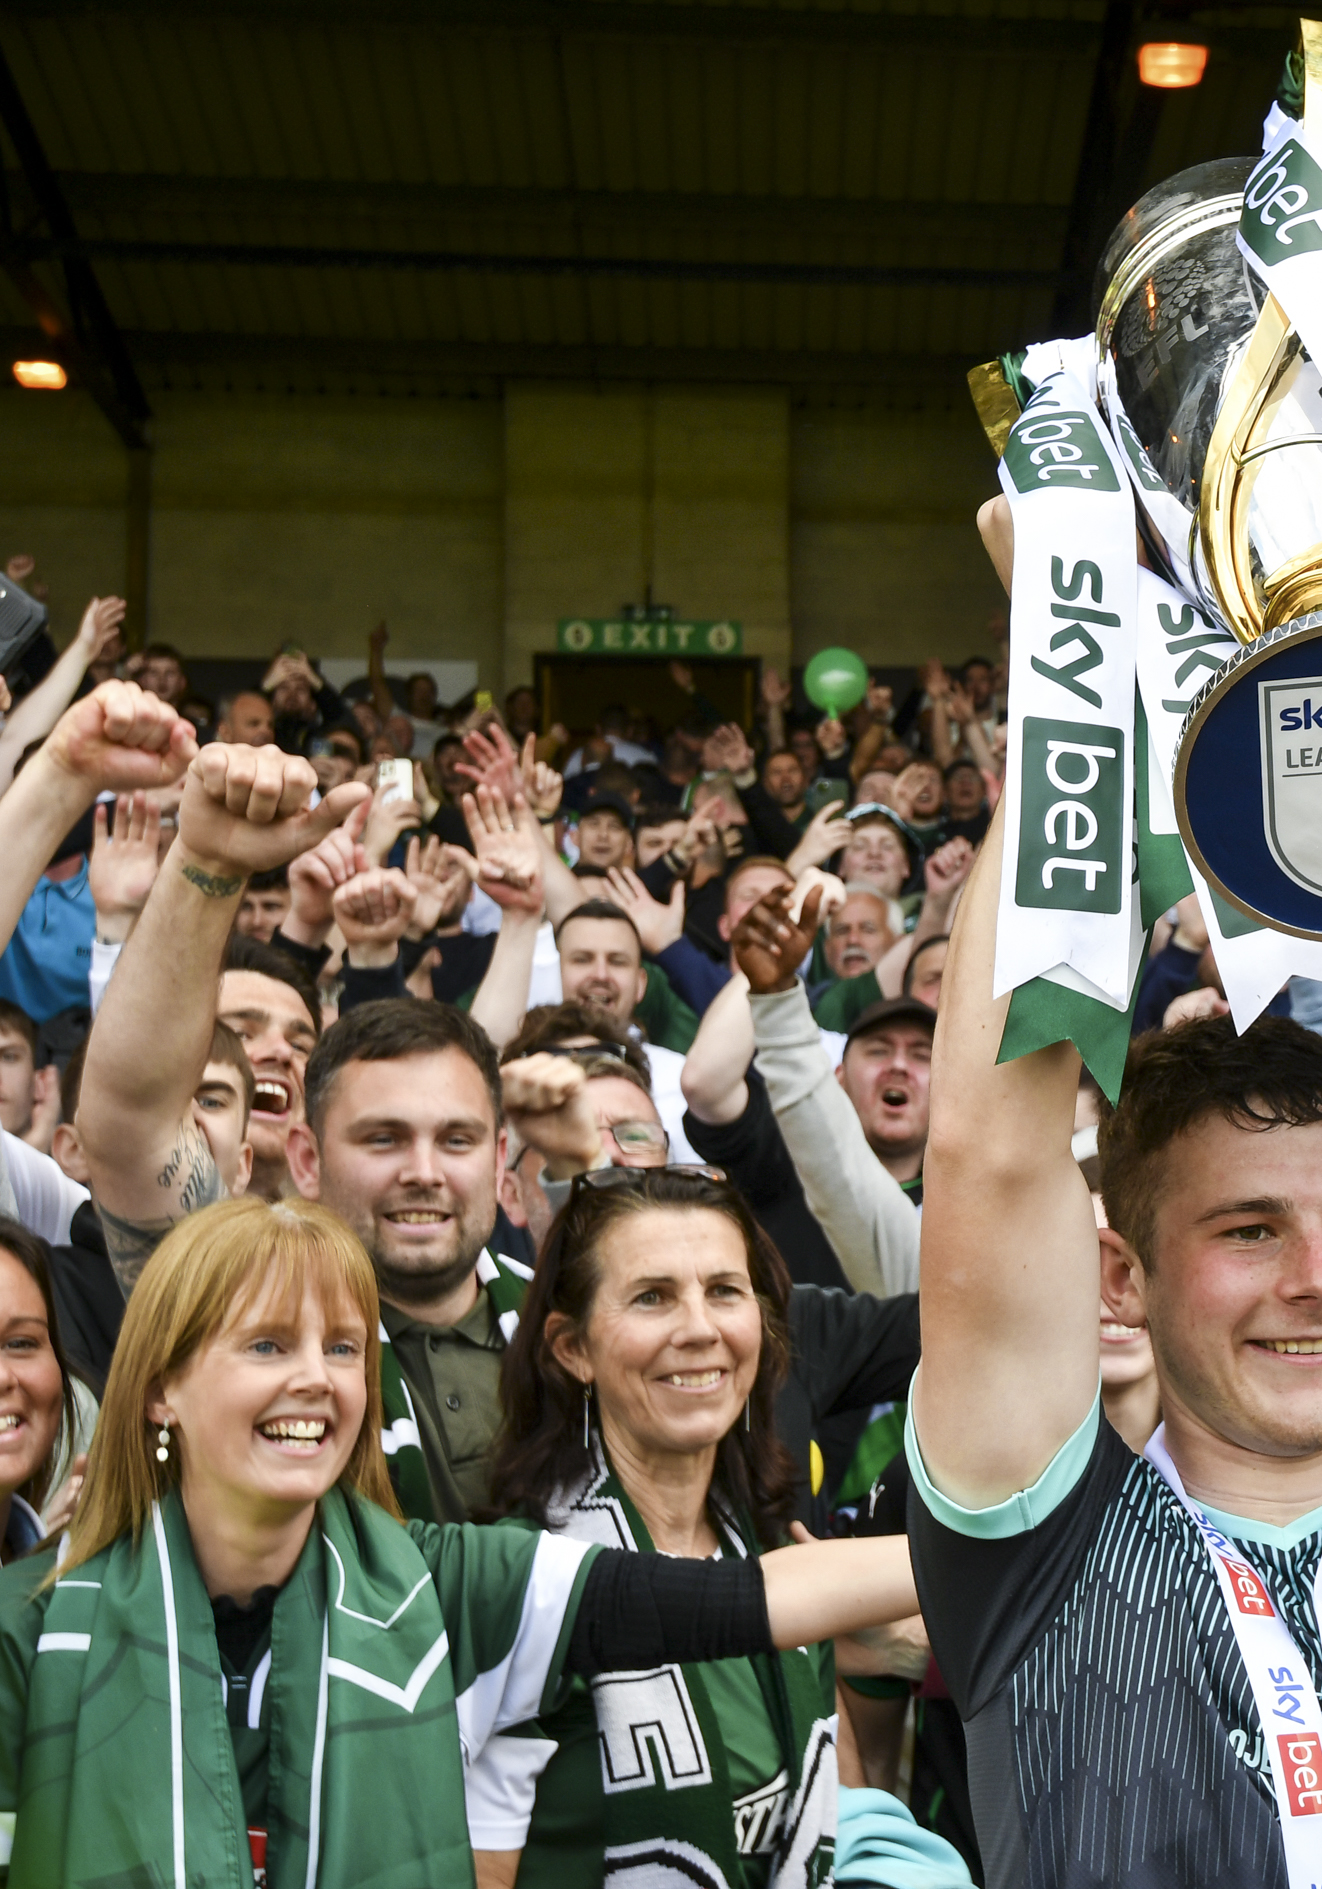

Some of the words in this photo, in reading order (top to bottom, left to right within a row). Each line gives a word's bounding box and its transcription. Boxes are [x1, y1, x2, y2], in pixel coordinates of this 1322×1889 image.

[1135, 313, 1210, 392] EFL
[1017, 417, 1100, 481] bet
[602, 622, 697, 650] EXIT
[1030, 553, 1122, 710] sky
[1040, 738, 1118, 893] bet
[1225, 1560, 1266, 1611] bet
[1268, 1666, 1306, 1726] sky
